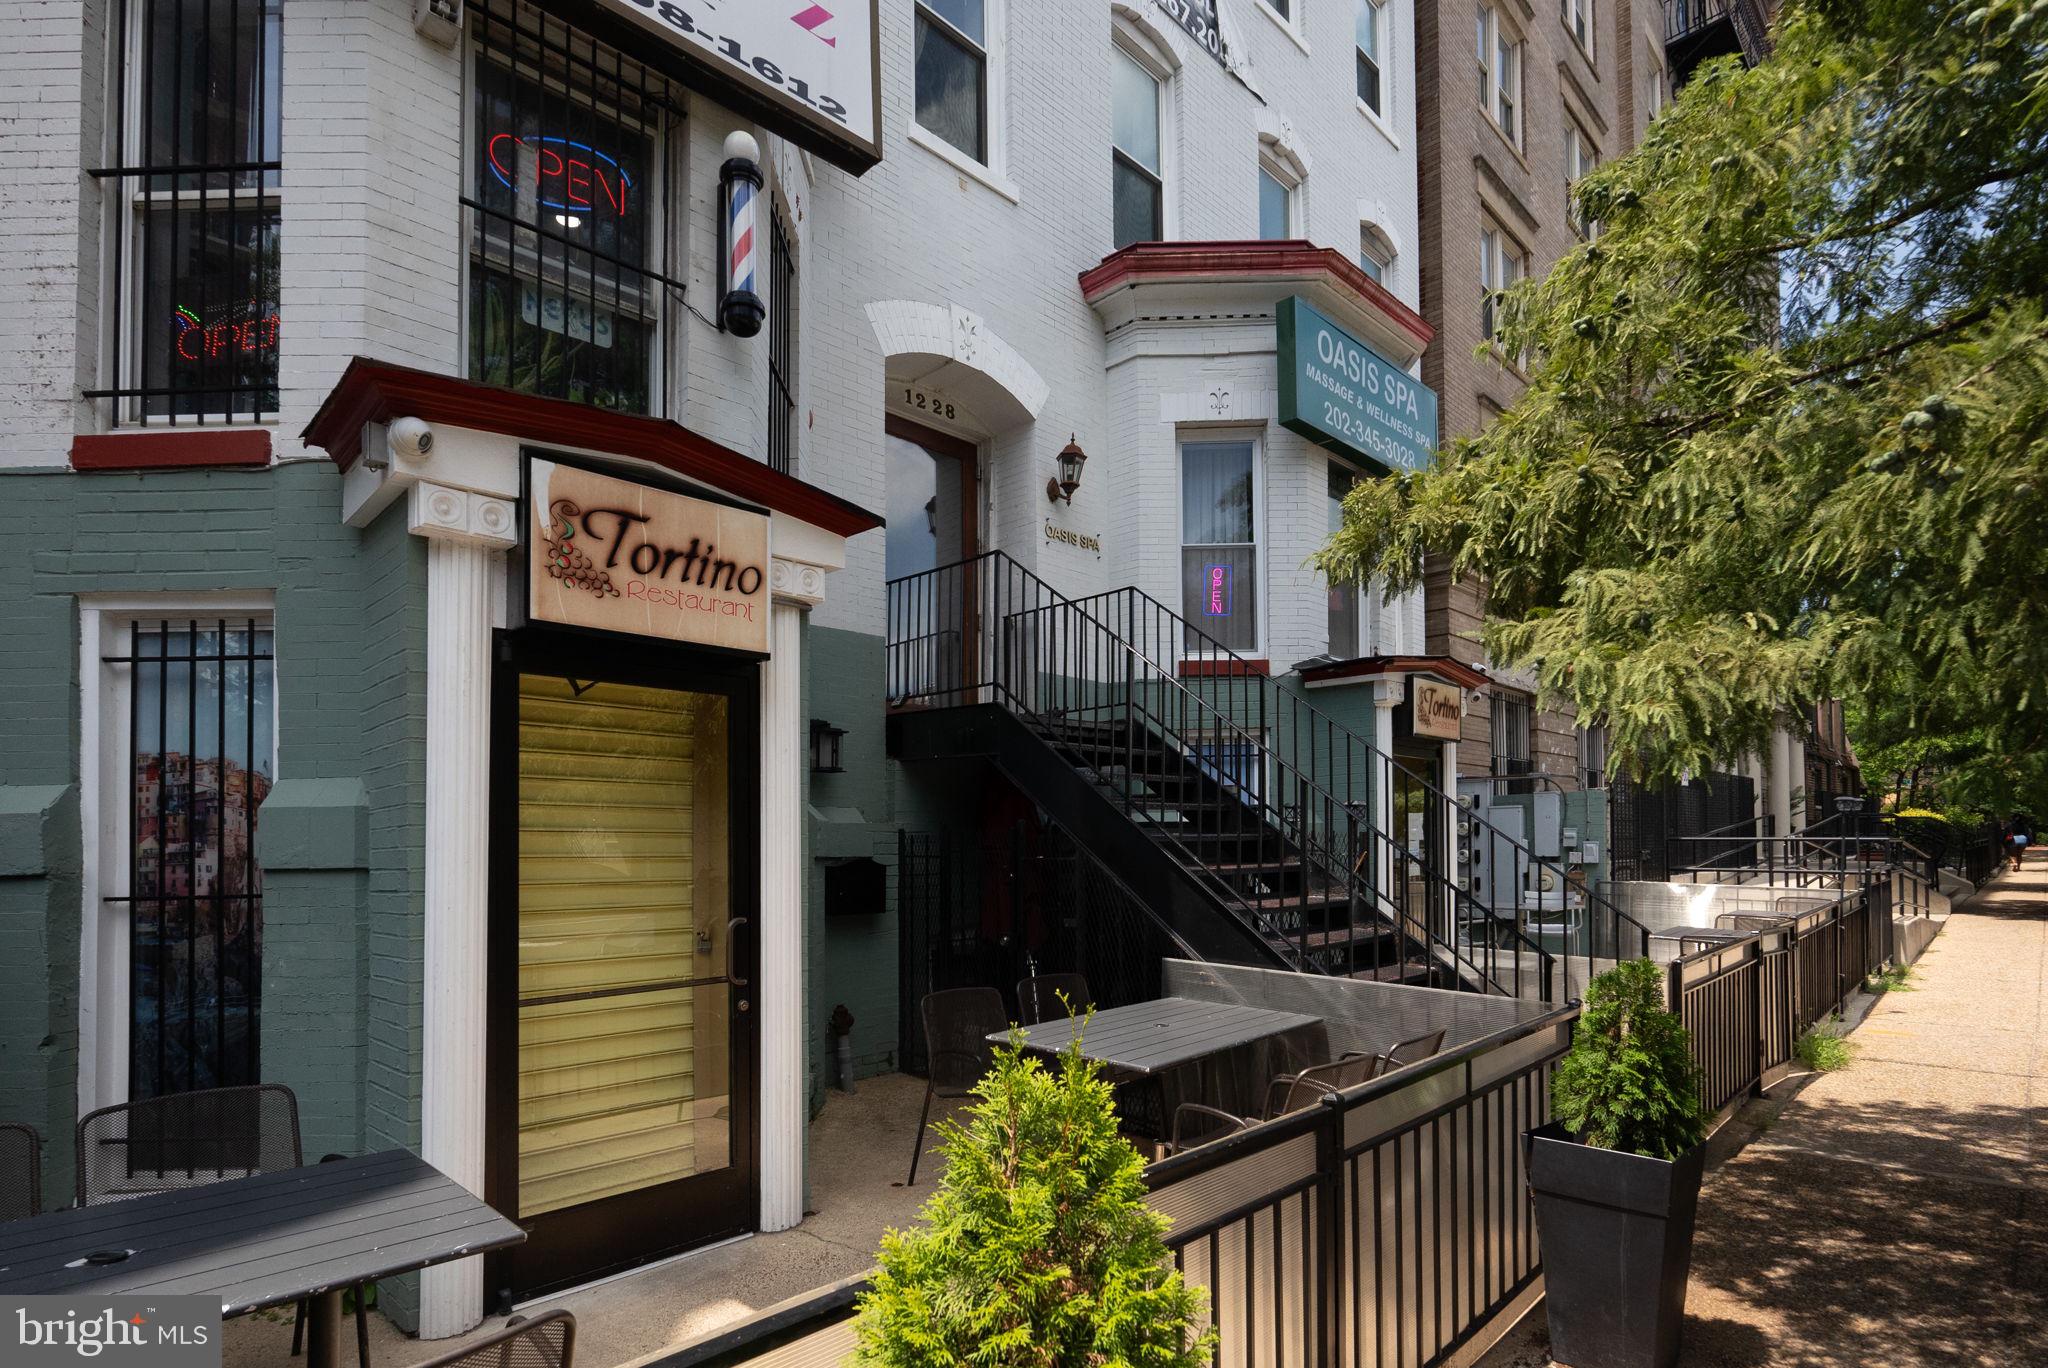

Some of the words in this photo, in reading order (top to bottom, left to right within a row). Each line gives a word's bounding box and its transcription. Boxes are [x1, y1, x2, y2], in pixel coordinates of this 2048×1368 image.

[631, 0, 847, 124] 8-1612
[489, 133, 625, 216] OPEN
[905, 389, 955, 420] 1228
[1306, 362, 1354, 405] MASSAGE
[1356, 395, 1363, 410] &
[1366, 401, 1413, 440] WELLNESS
[1414, 430, 1431, 449] SPA
[1317, 329, 1379, 395] OASIS
[1384, 374, 1419, 421] SPA
[1324, 401, 1416, 469] 202-345-3028
[581, 507, 763, 596] Tortino
[1045, 523, 1077, 547] OASIS
[1080, 534, 1100, 552] SPA
[627, 580, 755, 623] Restaurant
[1212, 567, 1222, 614] OPEN
[1424, 687, 1460, 720] Tortino
